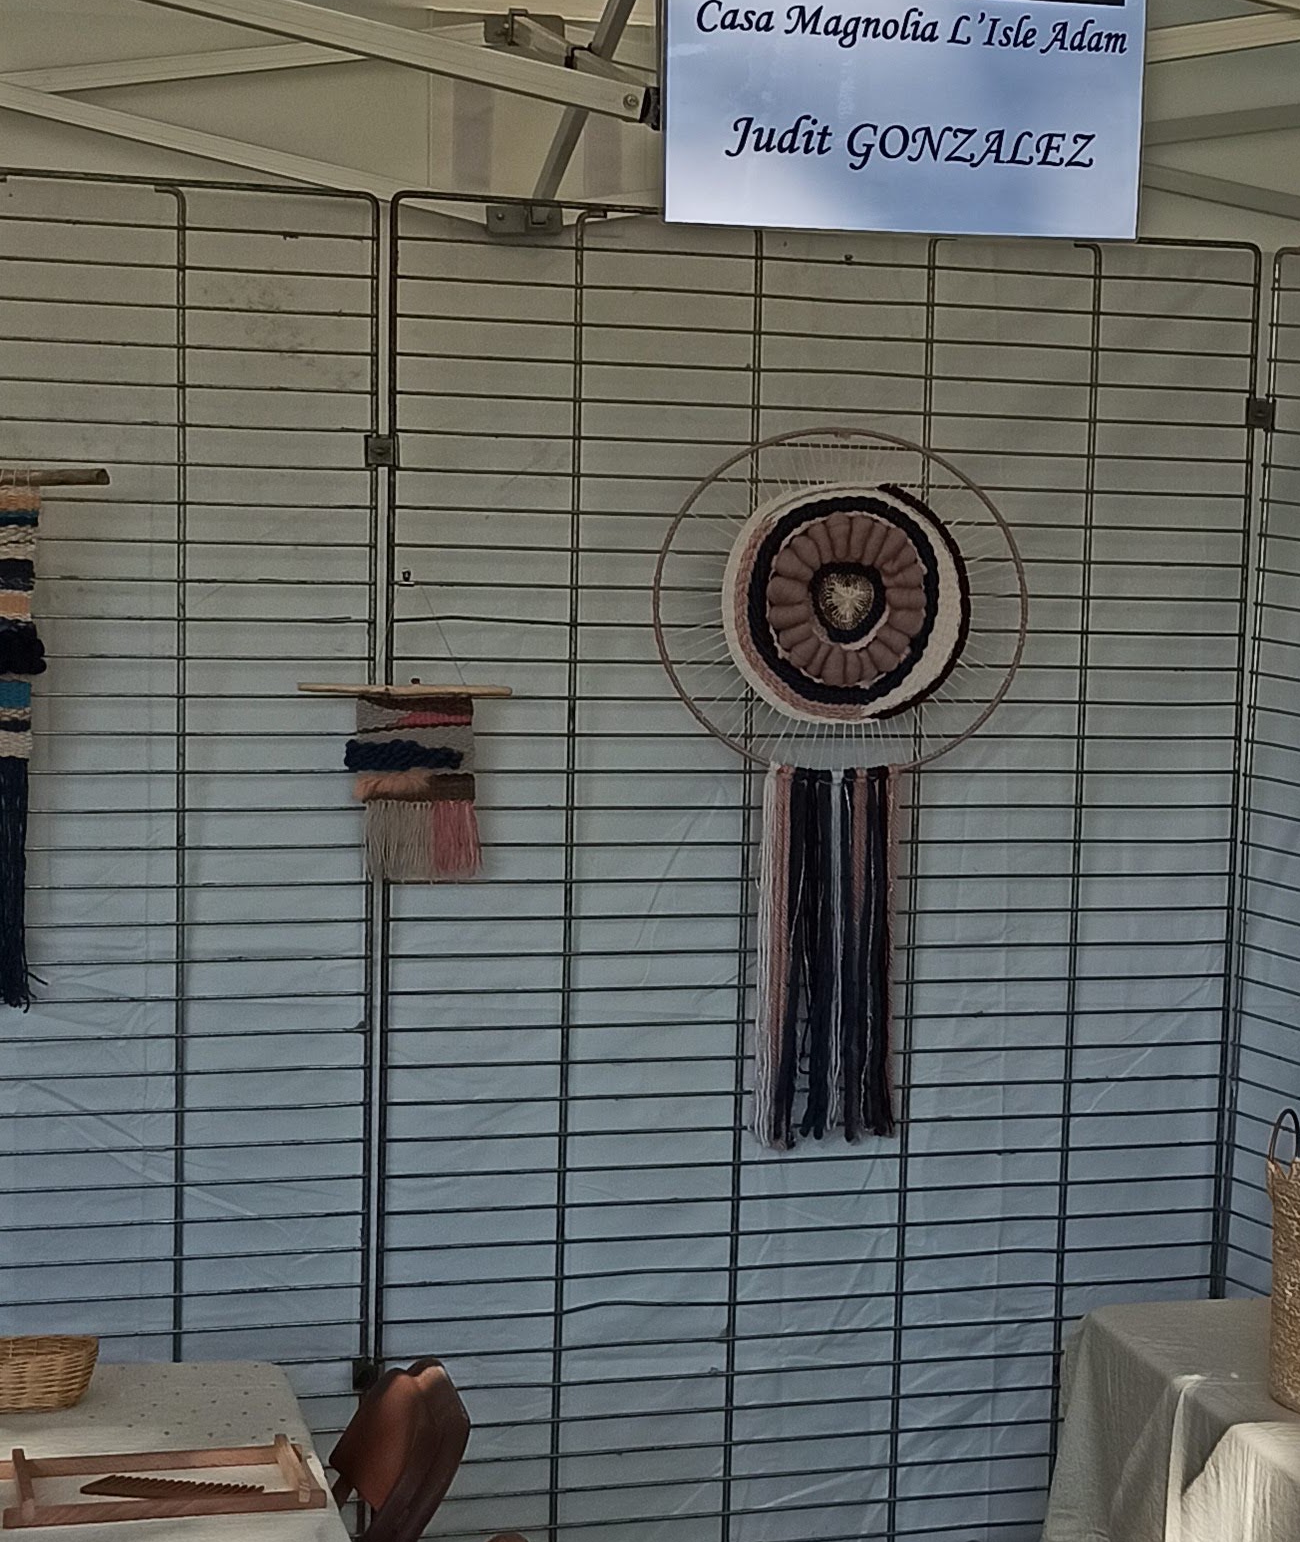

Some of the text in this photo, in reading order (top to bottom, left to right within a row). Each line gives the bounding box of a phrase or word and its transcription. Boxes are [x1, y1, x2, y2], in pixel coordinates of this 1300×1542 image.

[696, 0, 775, 34] Casa
[784, 4, 939, 48] Magnolia
[1040, 19, 1128, 55] Adam
[725, 115, 1096, 171] Judit GONZALEZ
